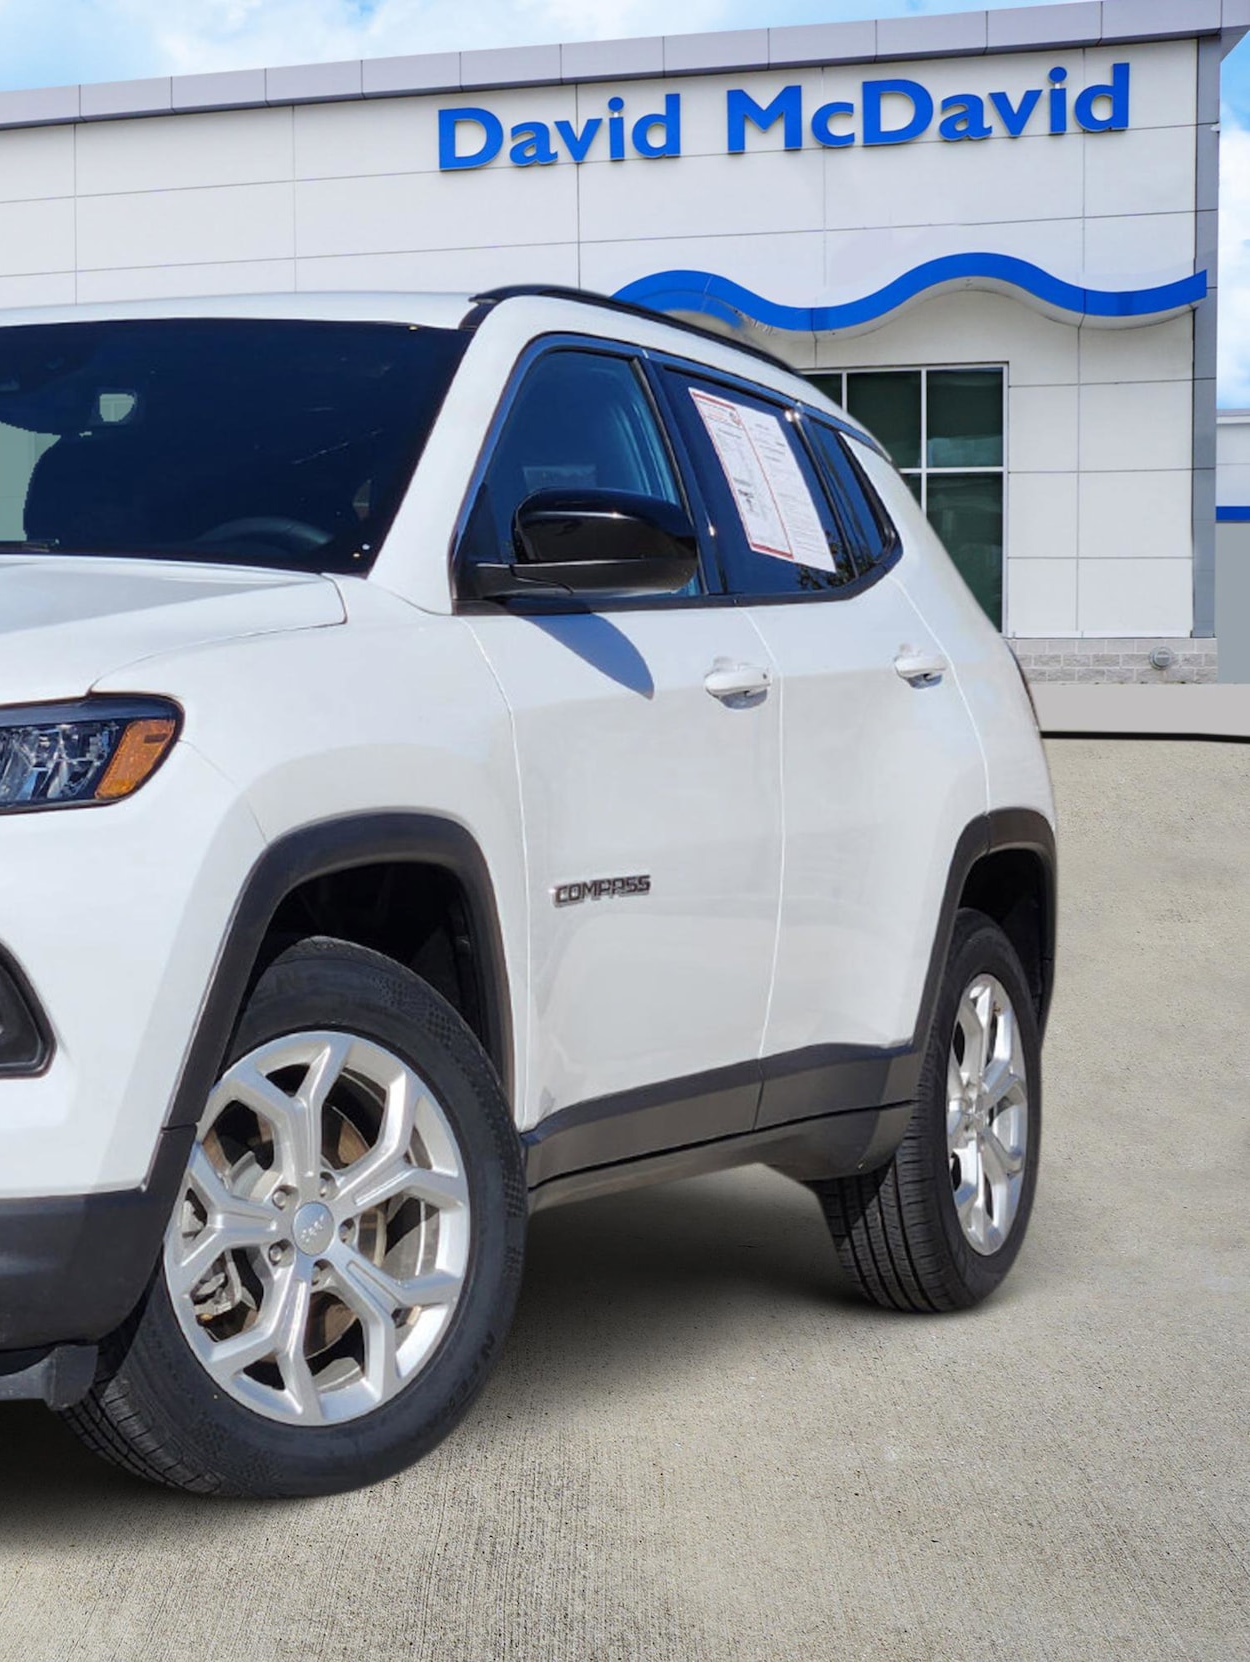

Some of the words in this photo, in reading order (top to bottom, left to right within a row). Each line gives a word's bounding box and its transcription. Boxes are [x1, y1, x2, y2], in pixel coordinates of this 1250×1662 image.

[438, 92, 681, 171] David
[726, 63, 1131, 156] McDavid
[554, 874, 652, 903] COMPASS
